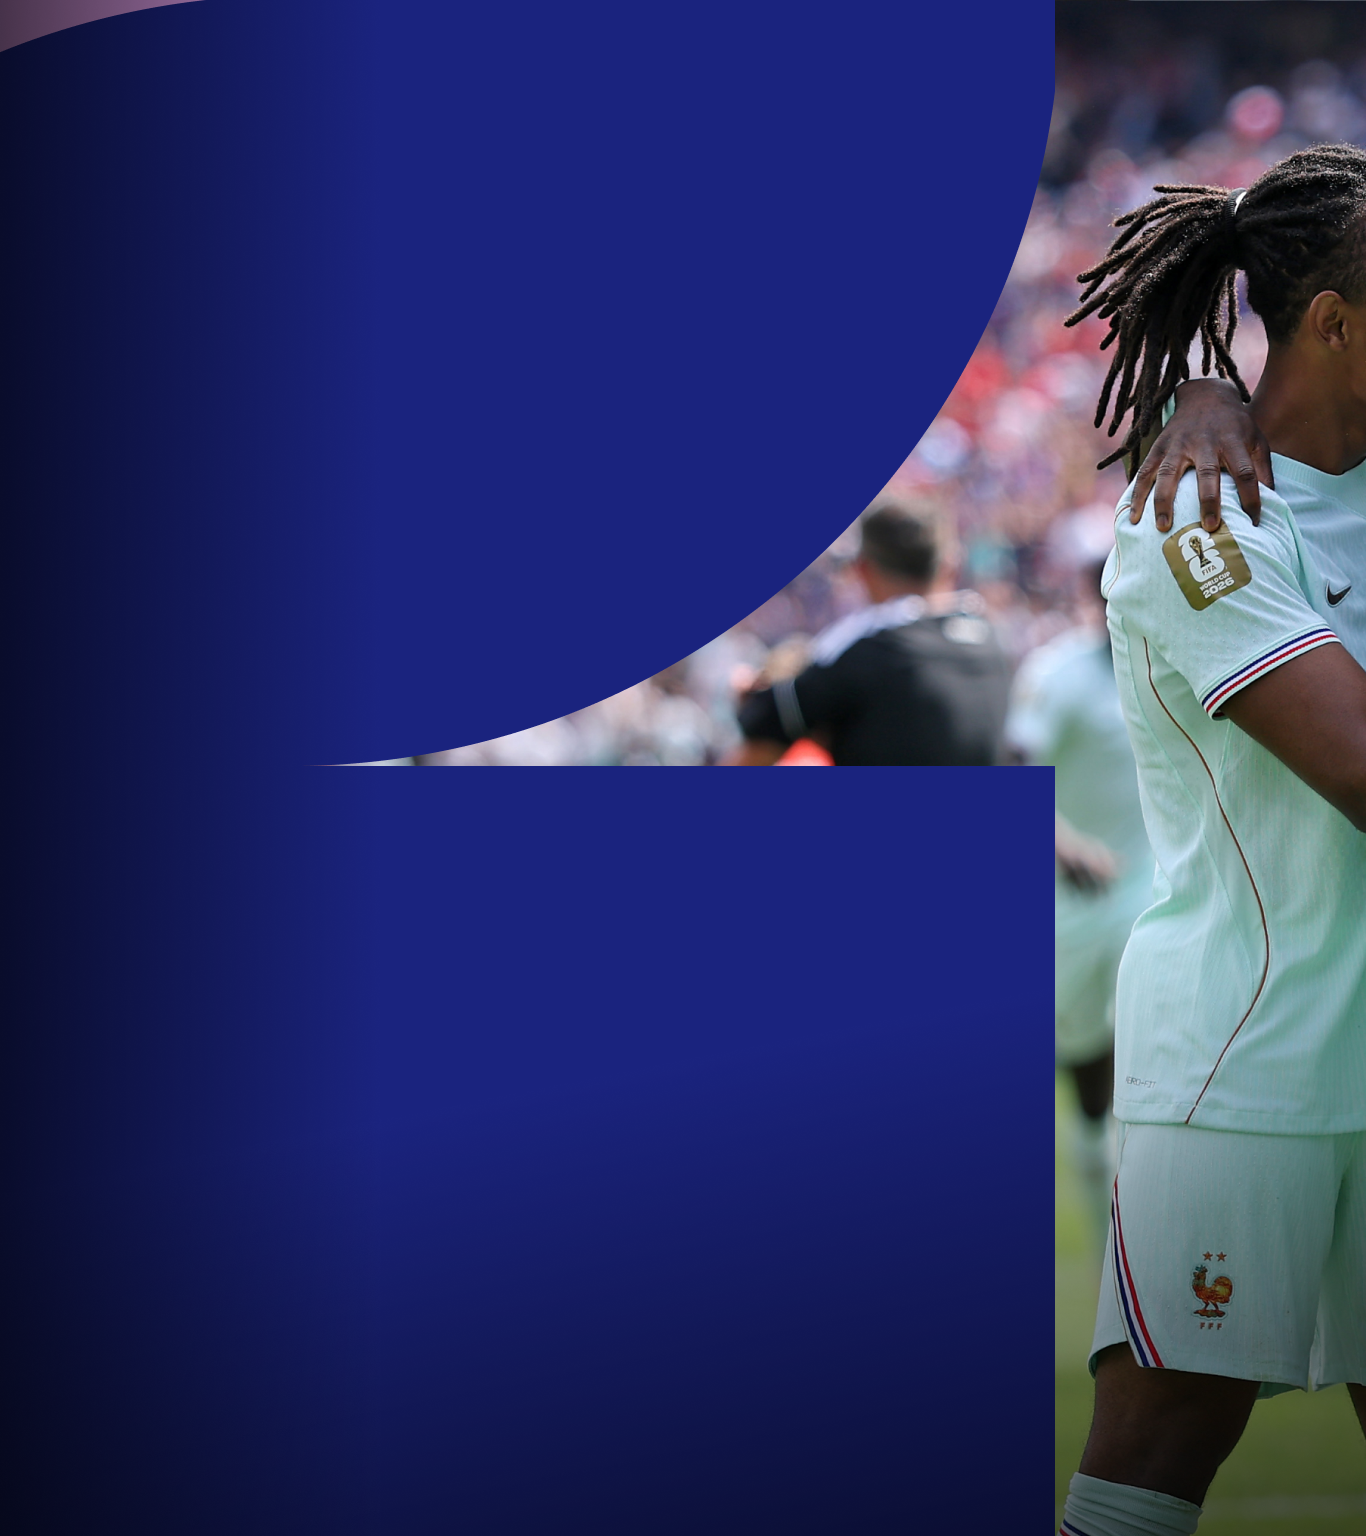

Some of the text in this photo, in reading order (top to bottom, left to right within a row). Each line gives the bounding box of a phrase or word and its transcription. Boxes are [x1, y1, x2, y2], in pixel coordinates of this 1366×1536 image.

[1202, 565, 1217, 575] FIFA
[1199, 571, 1231, 592] WORLD CUP
[1202, 576, 1235, 599] 2026
